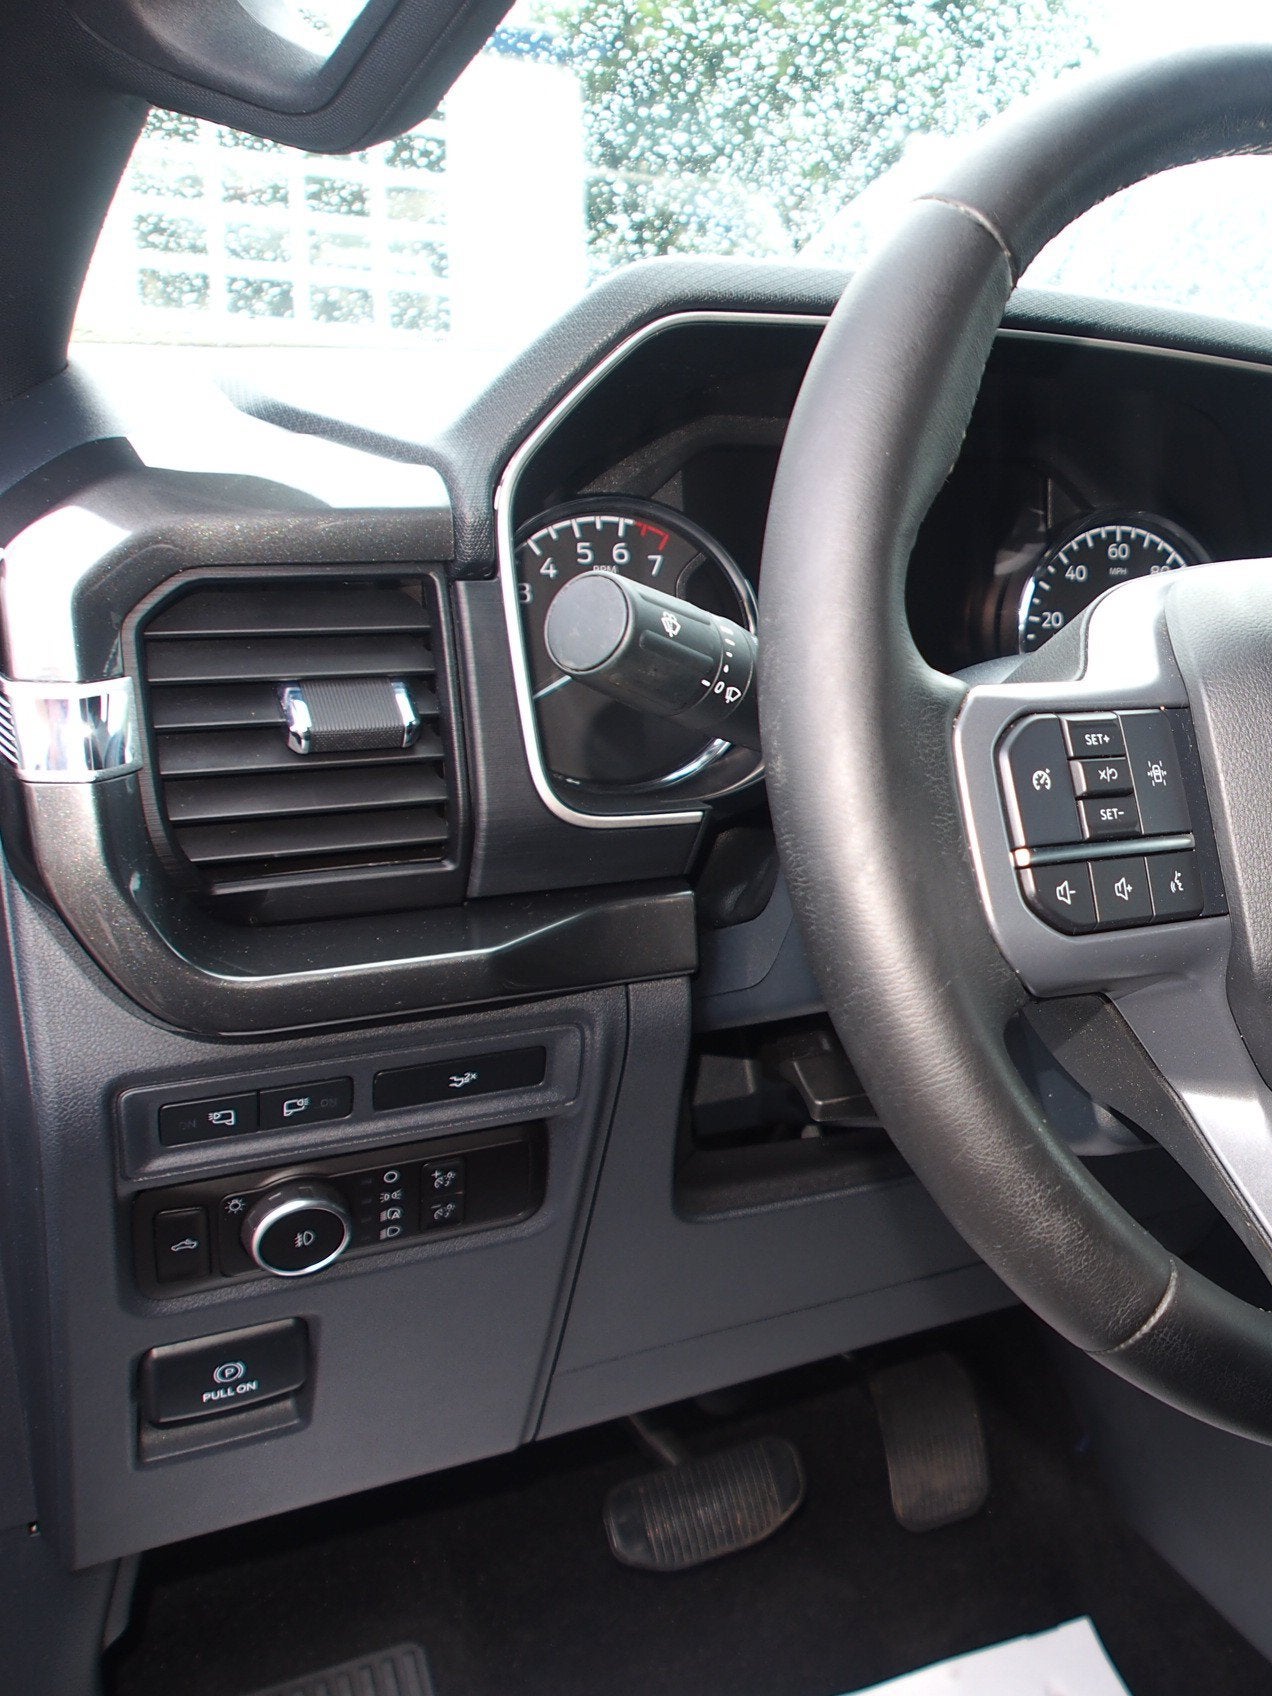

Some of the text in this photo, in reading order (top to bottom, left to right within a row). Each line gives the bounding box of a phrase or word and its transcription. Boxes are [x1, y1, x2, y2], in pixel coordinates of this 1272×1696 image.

[576, 542, 594, 564] 5
[612, 542, 630, 564] 6
[1107, 543, 1130, 560] 60
[539, 557, 558, 578] 4
[647, 554, 663, 577] 7
[1065, 565, 1087, 582] 40
[518, 582, 533, 603] 3
[1041, 612, 1064, 628] 20
[1084, 733, 1110, 746] SET+
[1100, 807, 1125, 821] SET-
[225, 1367, 235, 1378] P
[202, 1380, 258, 1402] PULL ON
